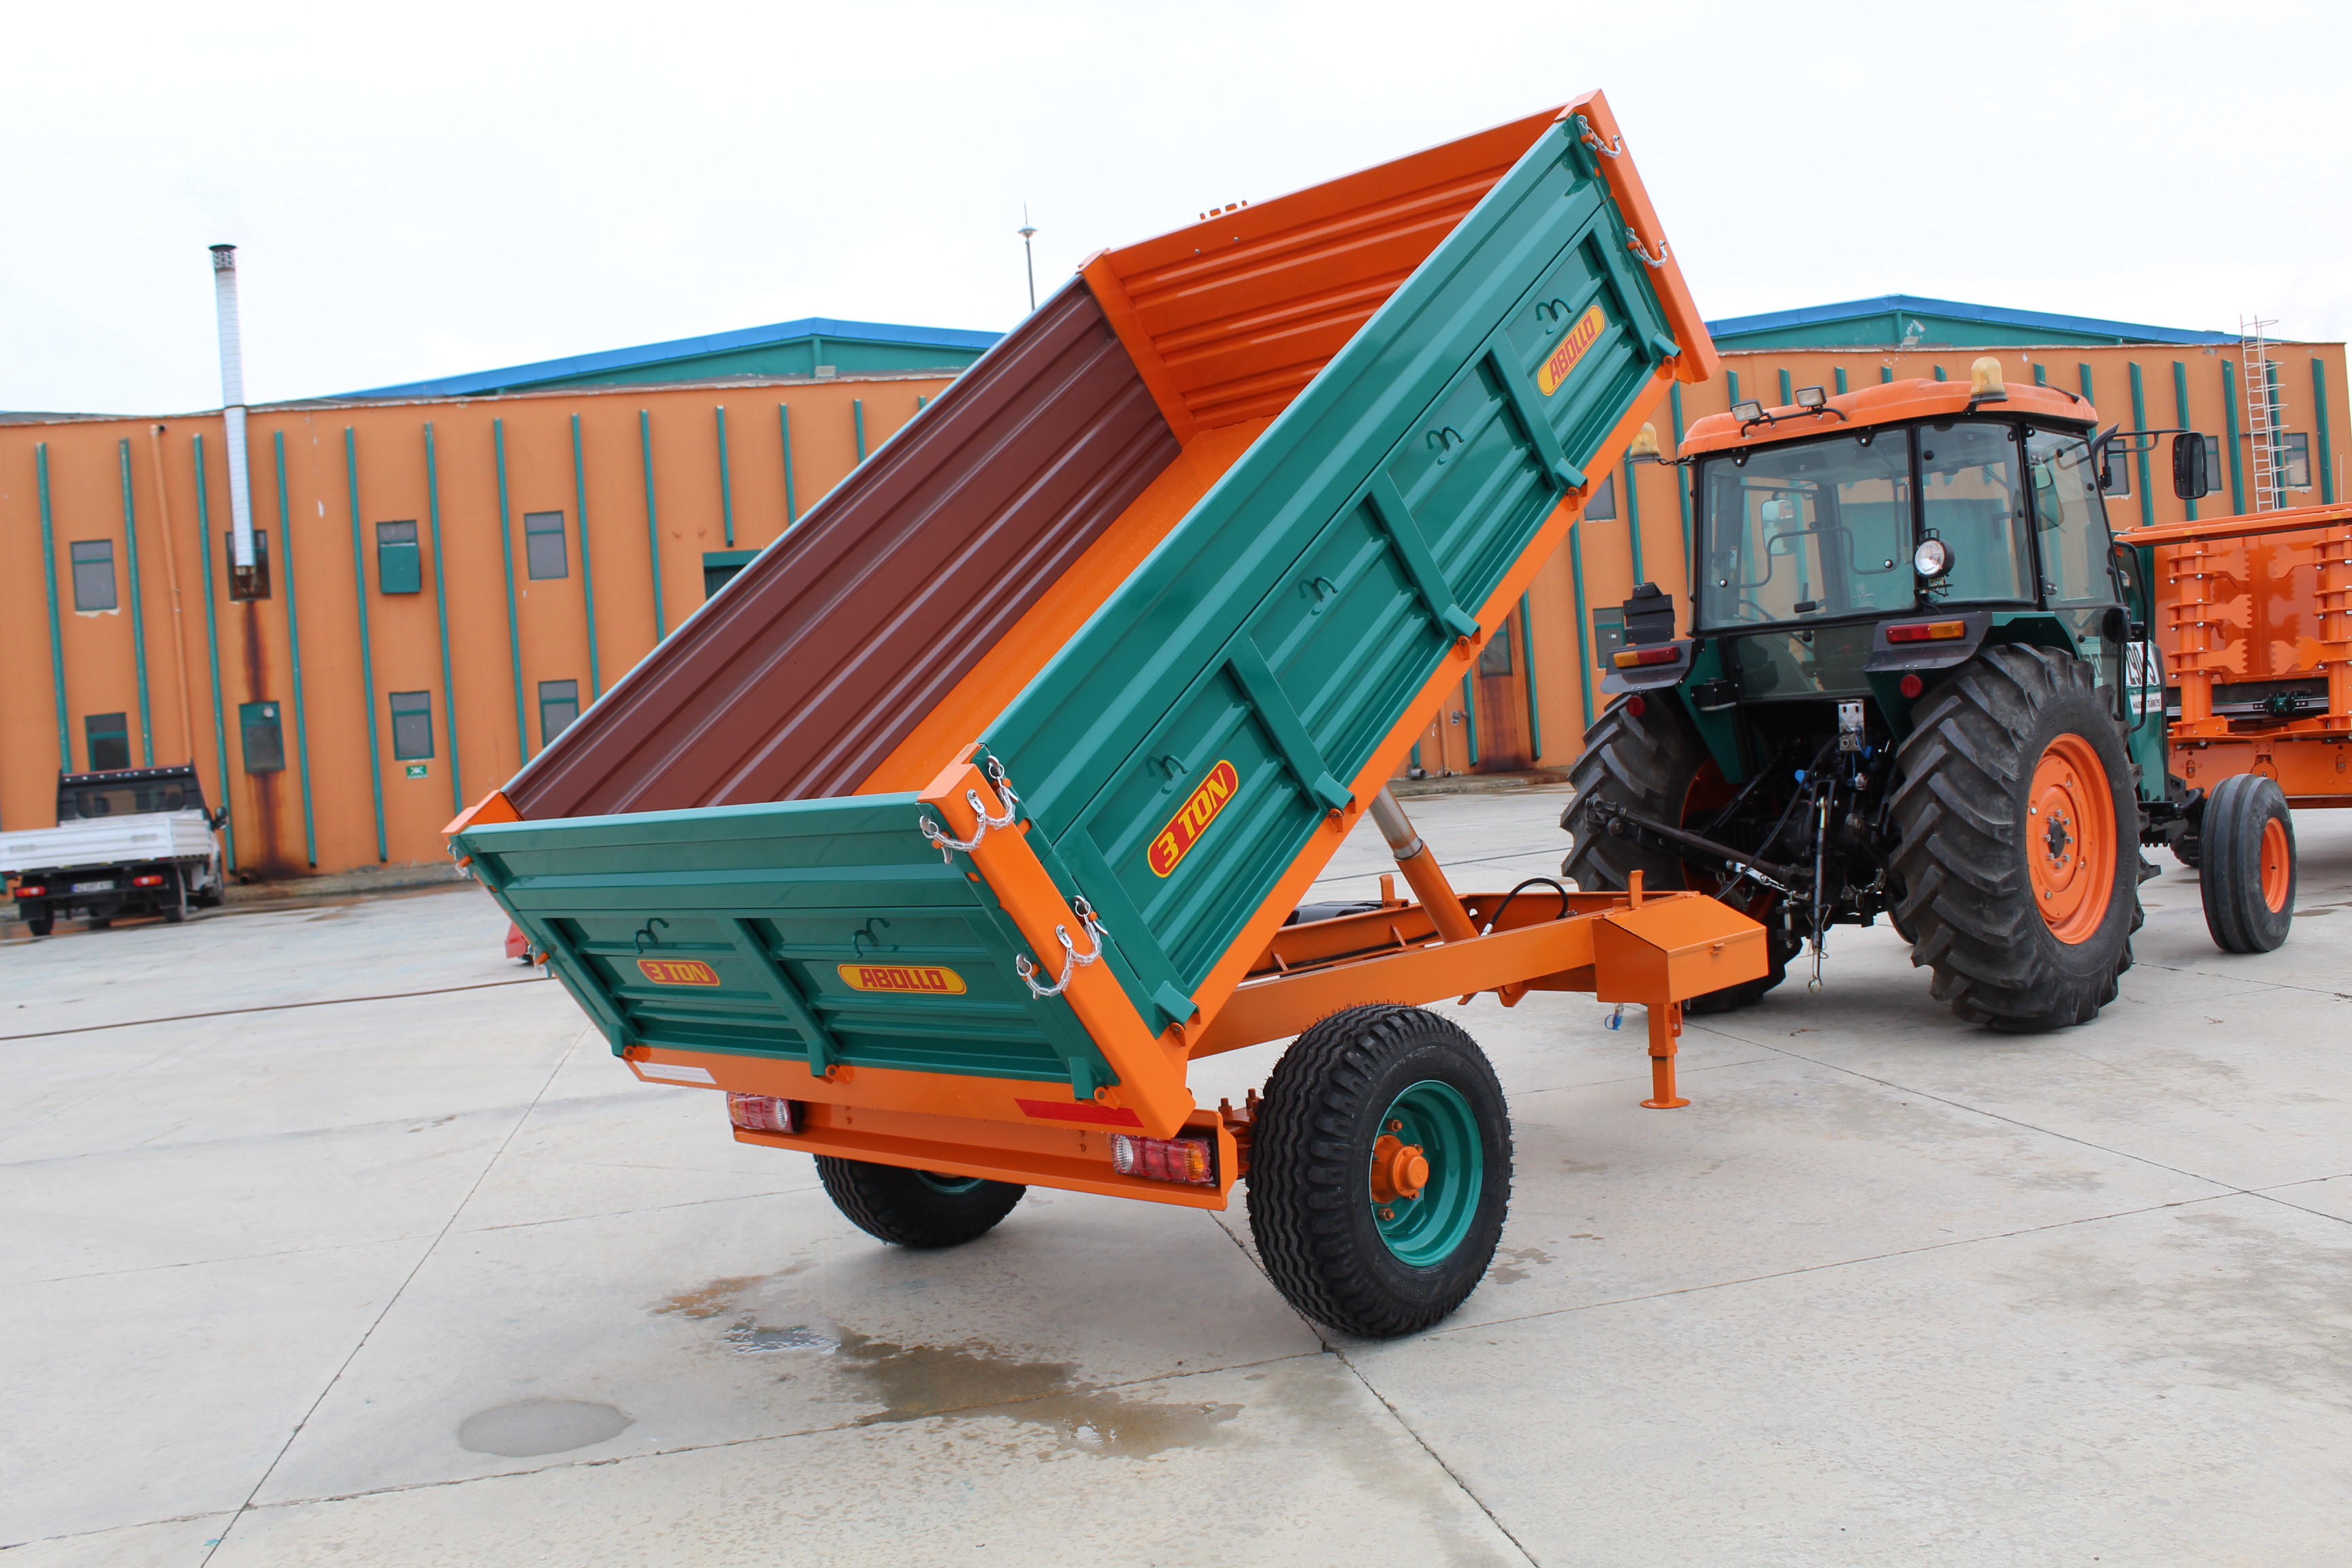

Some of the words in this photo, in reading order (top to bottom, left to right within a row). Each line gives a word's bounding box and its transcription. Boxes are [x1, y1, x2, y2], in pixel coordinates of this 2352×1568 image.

[1549, 314, 1596, 387] ABOLLO
[1158, 831, 1179, 868] 3
[1178, 768, 1228, 840] TON
[646, 963, 666, 980] 3
[664, 964, 710, 981] TON
[859, 968, 948, 990] ABOLLO
